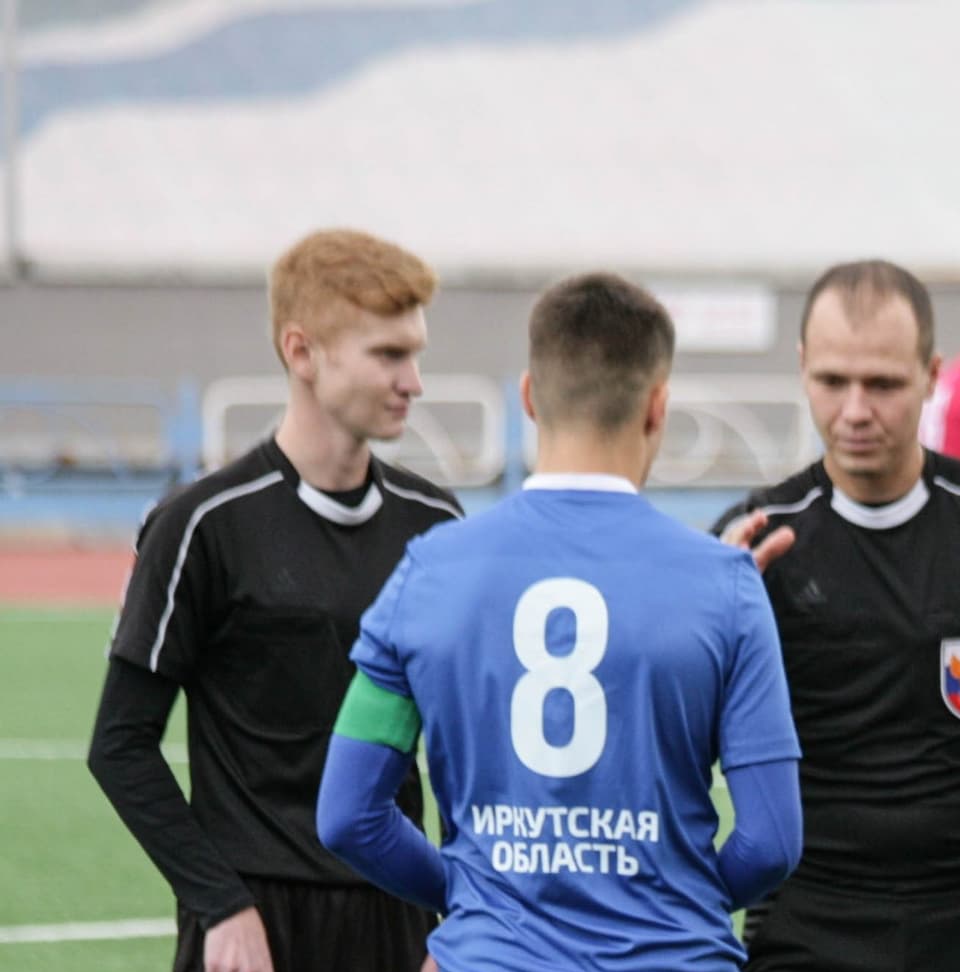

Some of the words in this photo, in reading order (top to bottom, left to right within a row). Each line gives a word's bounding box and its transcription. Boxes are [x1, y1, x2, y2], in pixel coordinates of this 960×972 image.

[510, 577, 609, 778] 8
[472, 805, 660, 843] ИРКУТСКАЯ
[491, 840, 640, 876] ОБЛАСТЬ
